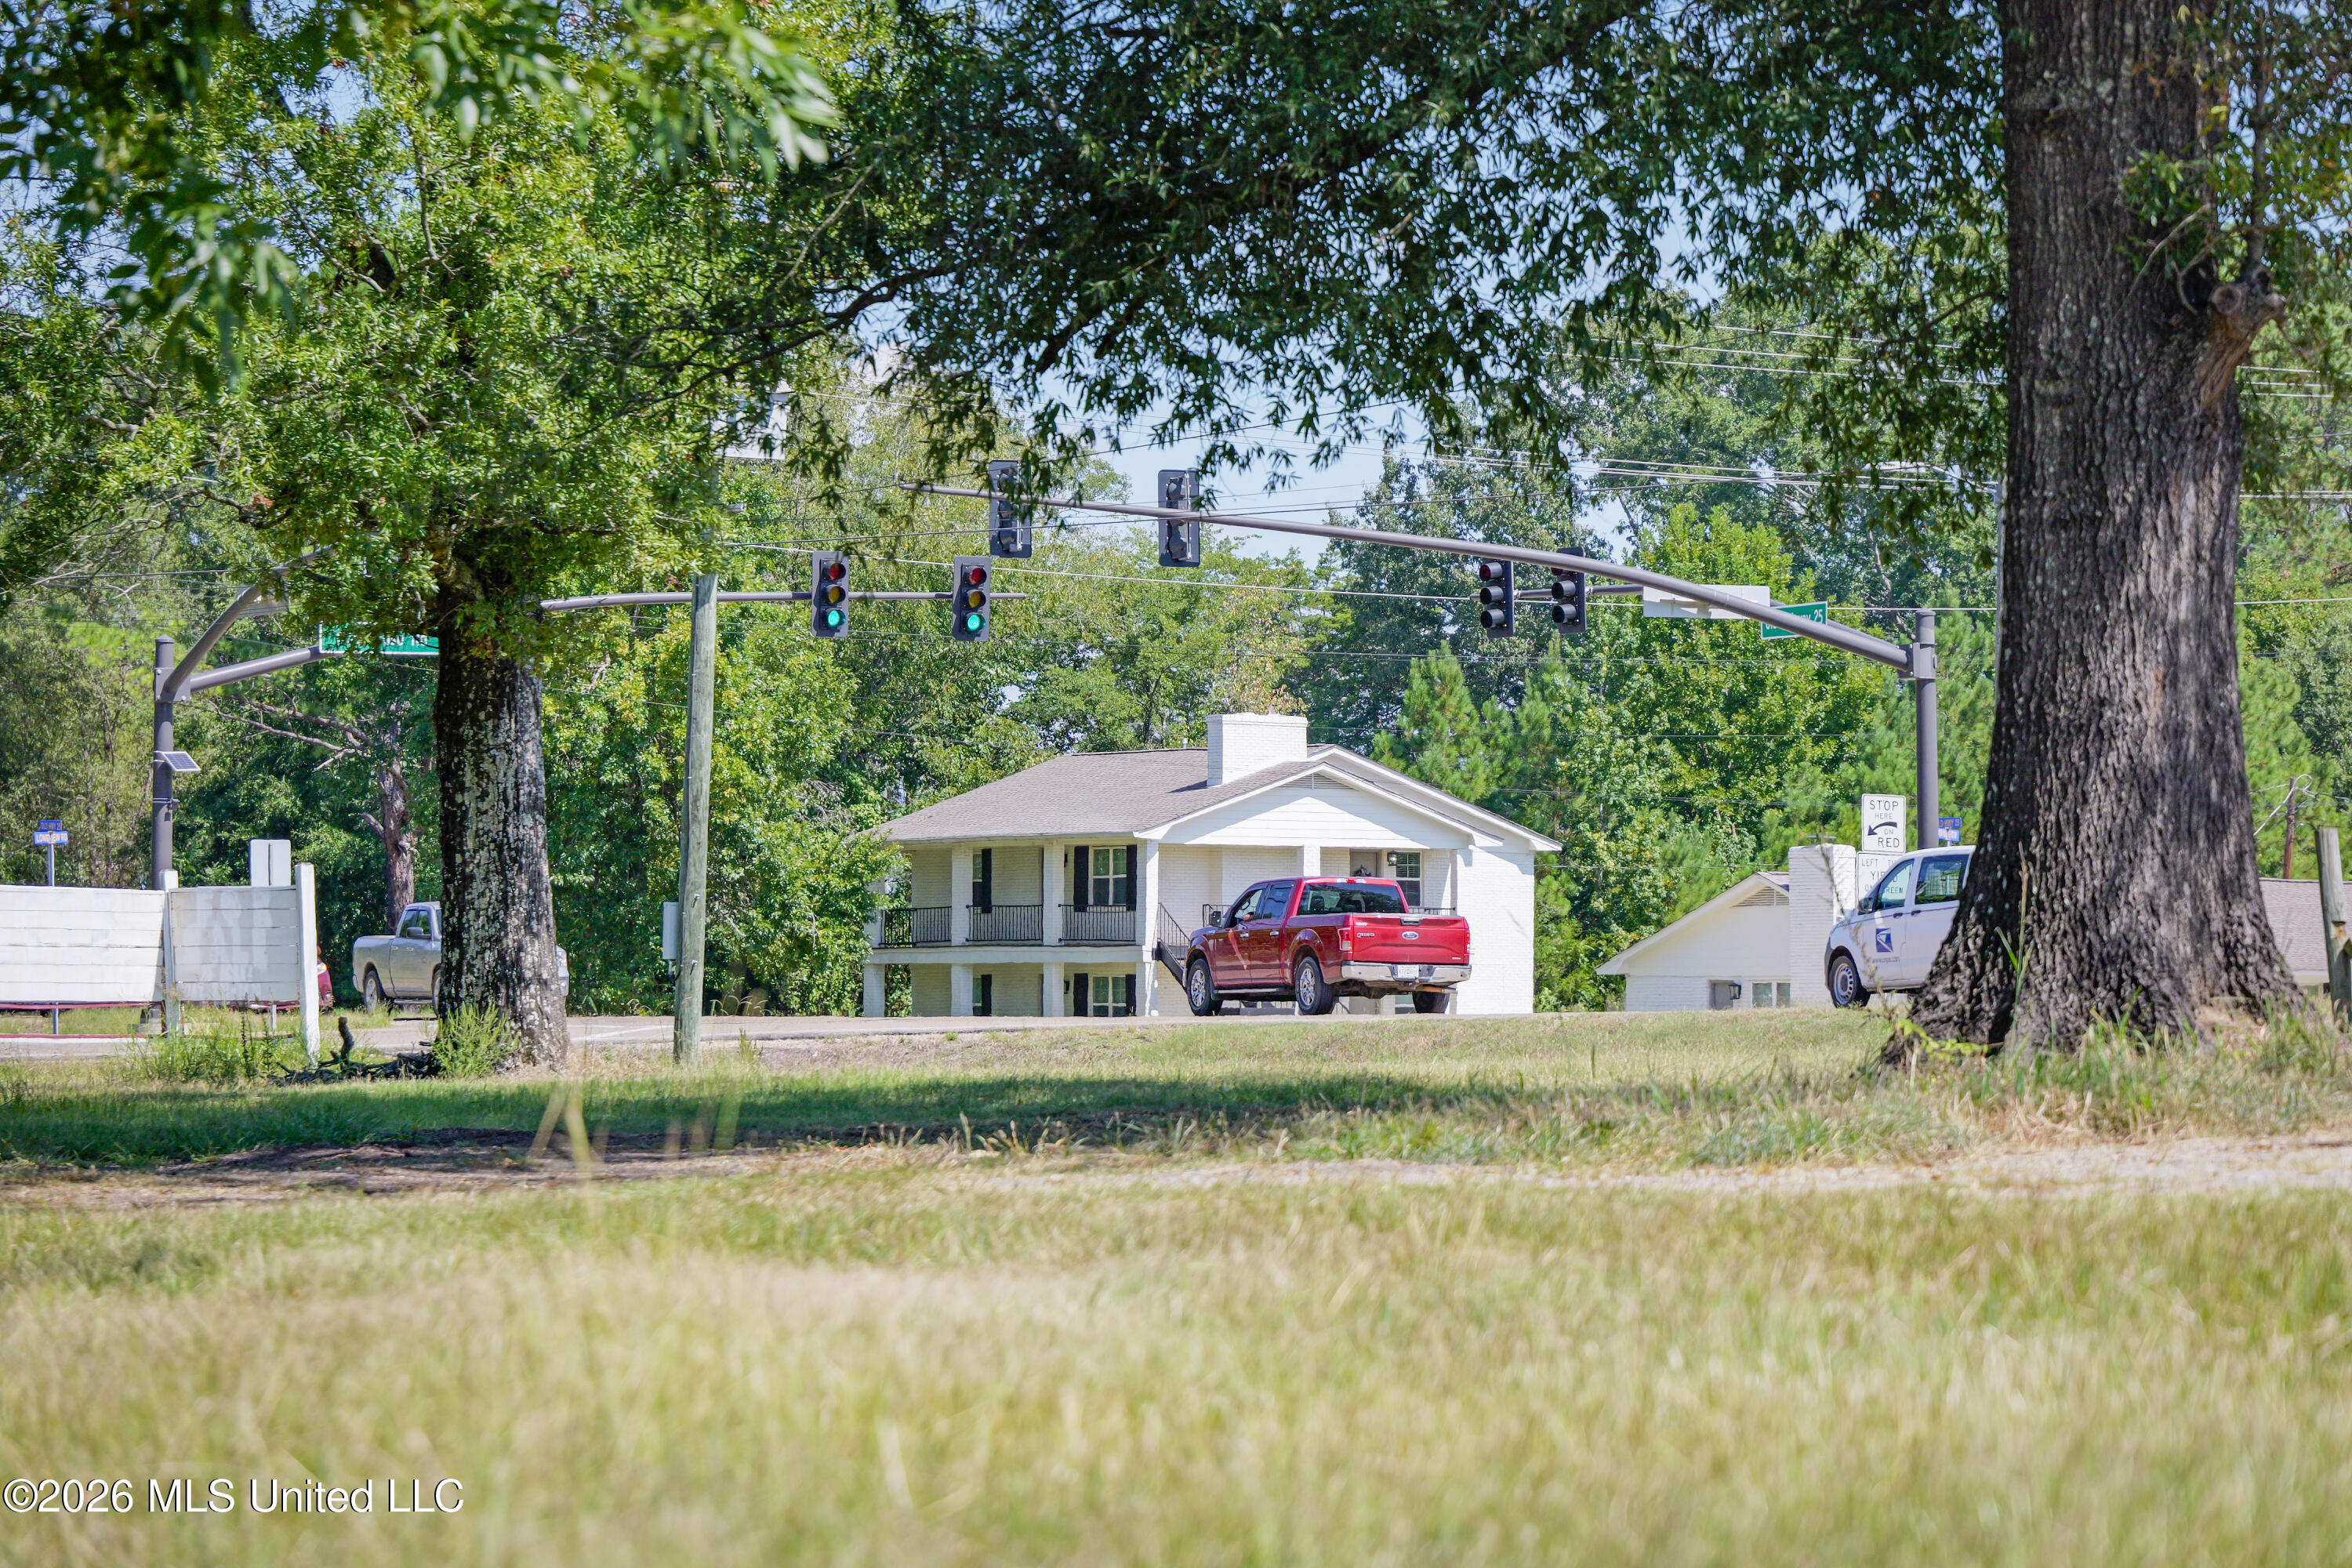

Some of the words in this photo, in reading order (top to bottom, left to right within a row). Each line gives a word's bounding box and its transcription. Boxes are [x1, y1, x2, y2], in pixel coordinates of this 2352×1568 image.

[1869, 800, 1899, 811] STOP
[1878, 837, 1900, 848] RED
[1861, 858, 1879, 867] LEFT
